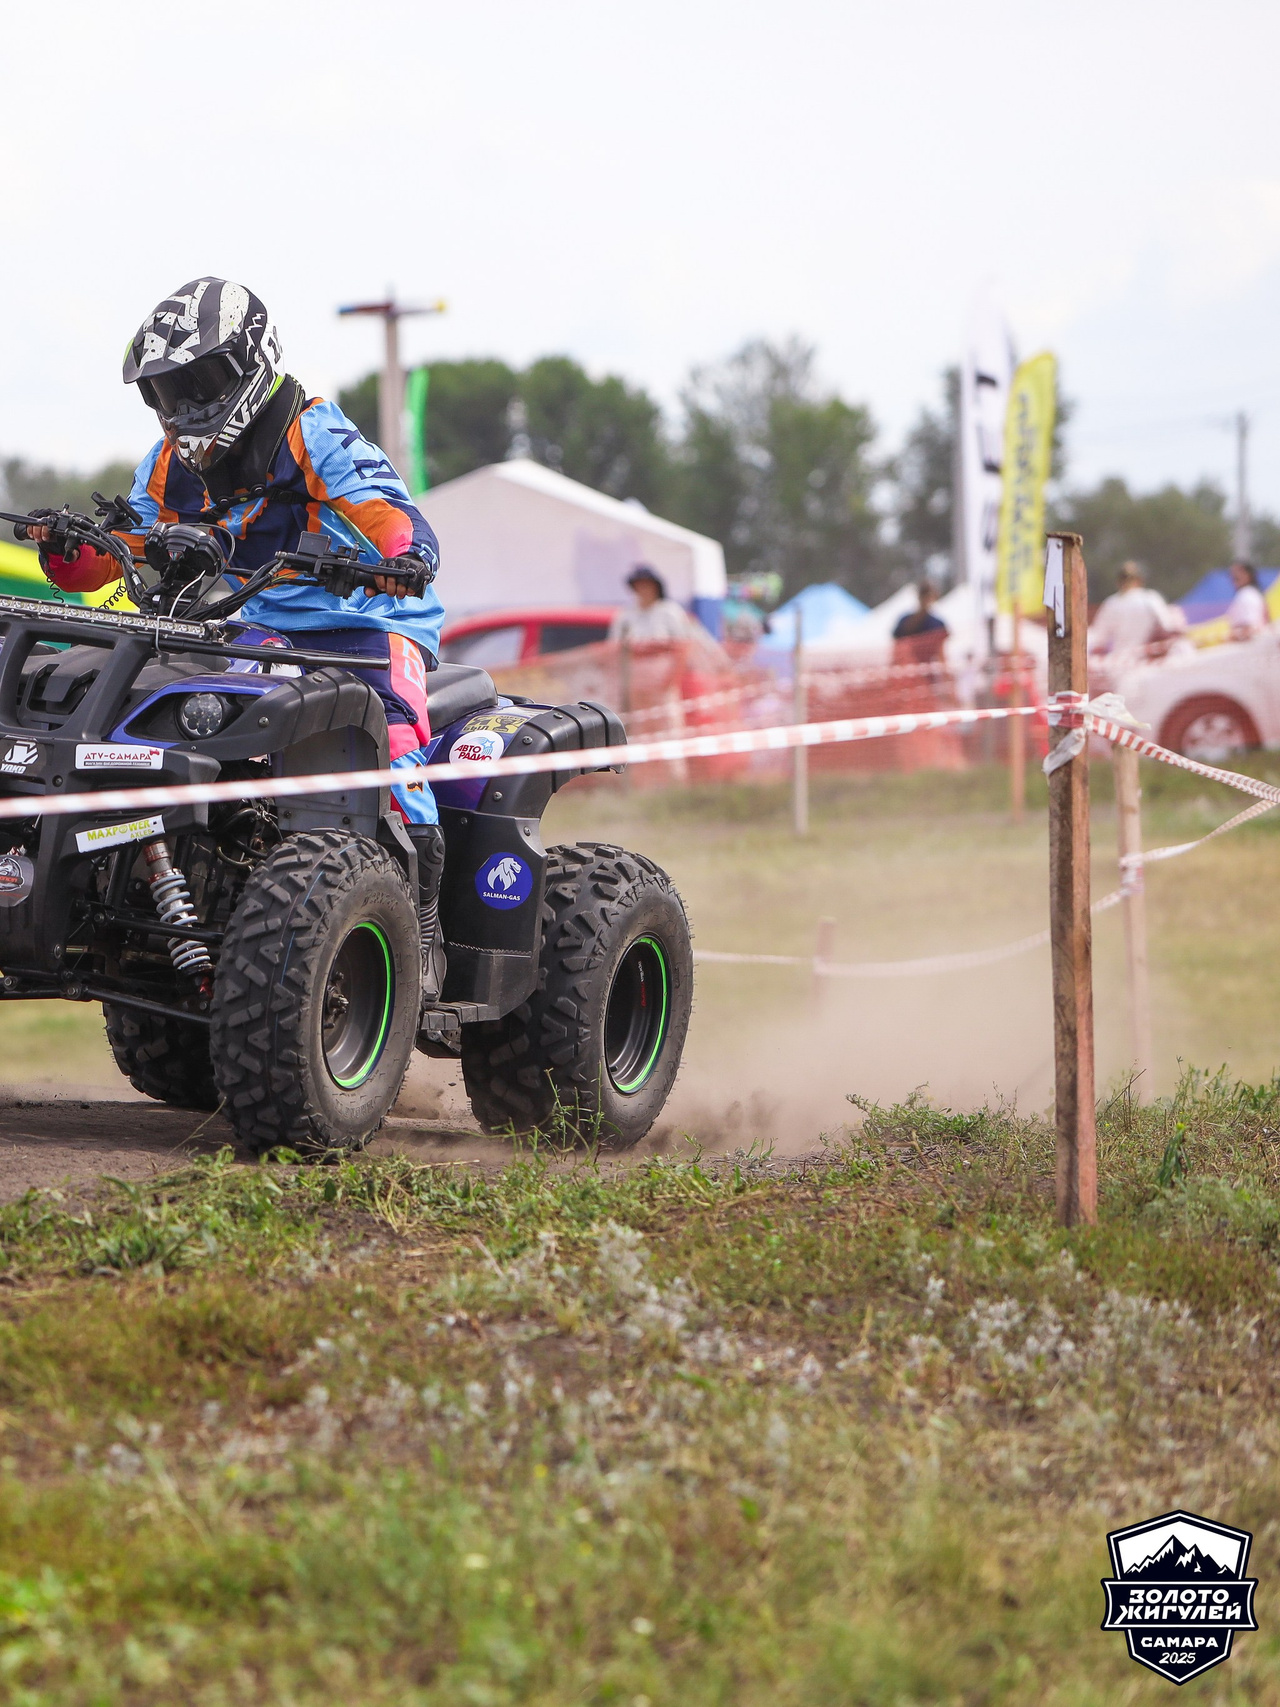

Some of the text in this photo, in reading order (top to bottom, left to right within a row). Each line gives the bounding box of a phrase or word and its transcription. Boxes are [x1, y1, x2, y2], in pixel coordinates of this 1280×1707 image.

[454, 744, 482, 753] АВТО
[86, 819, 151, 841] MAXPOWER
[483, 891, 521, 901] SALMAN-GAS
